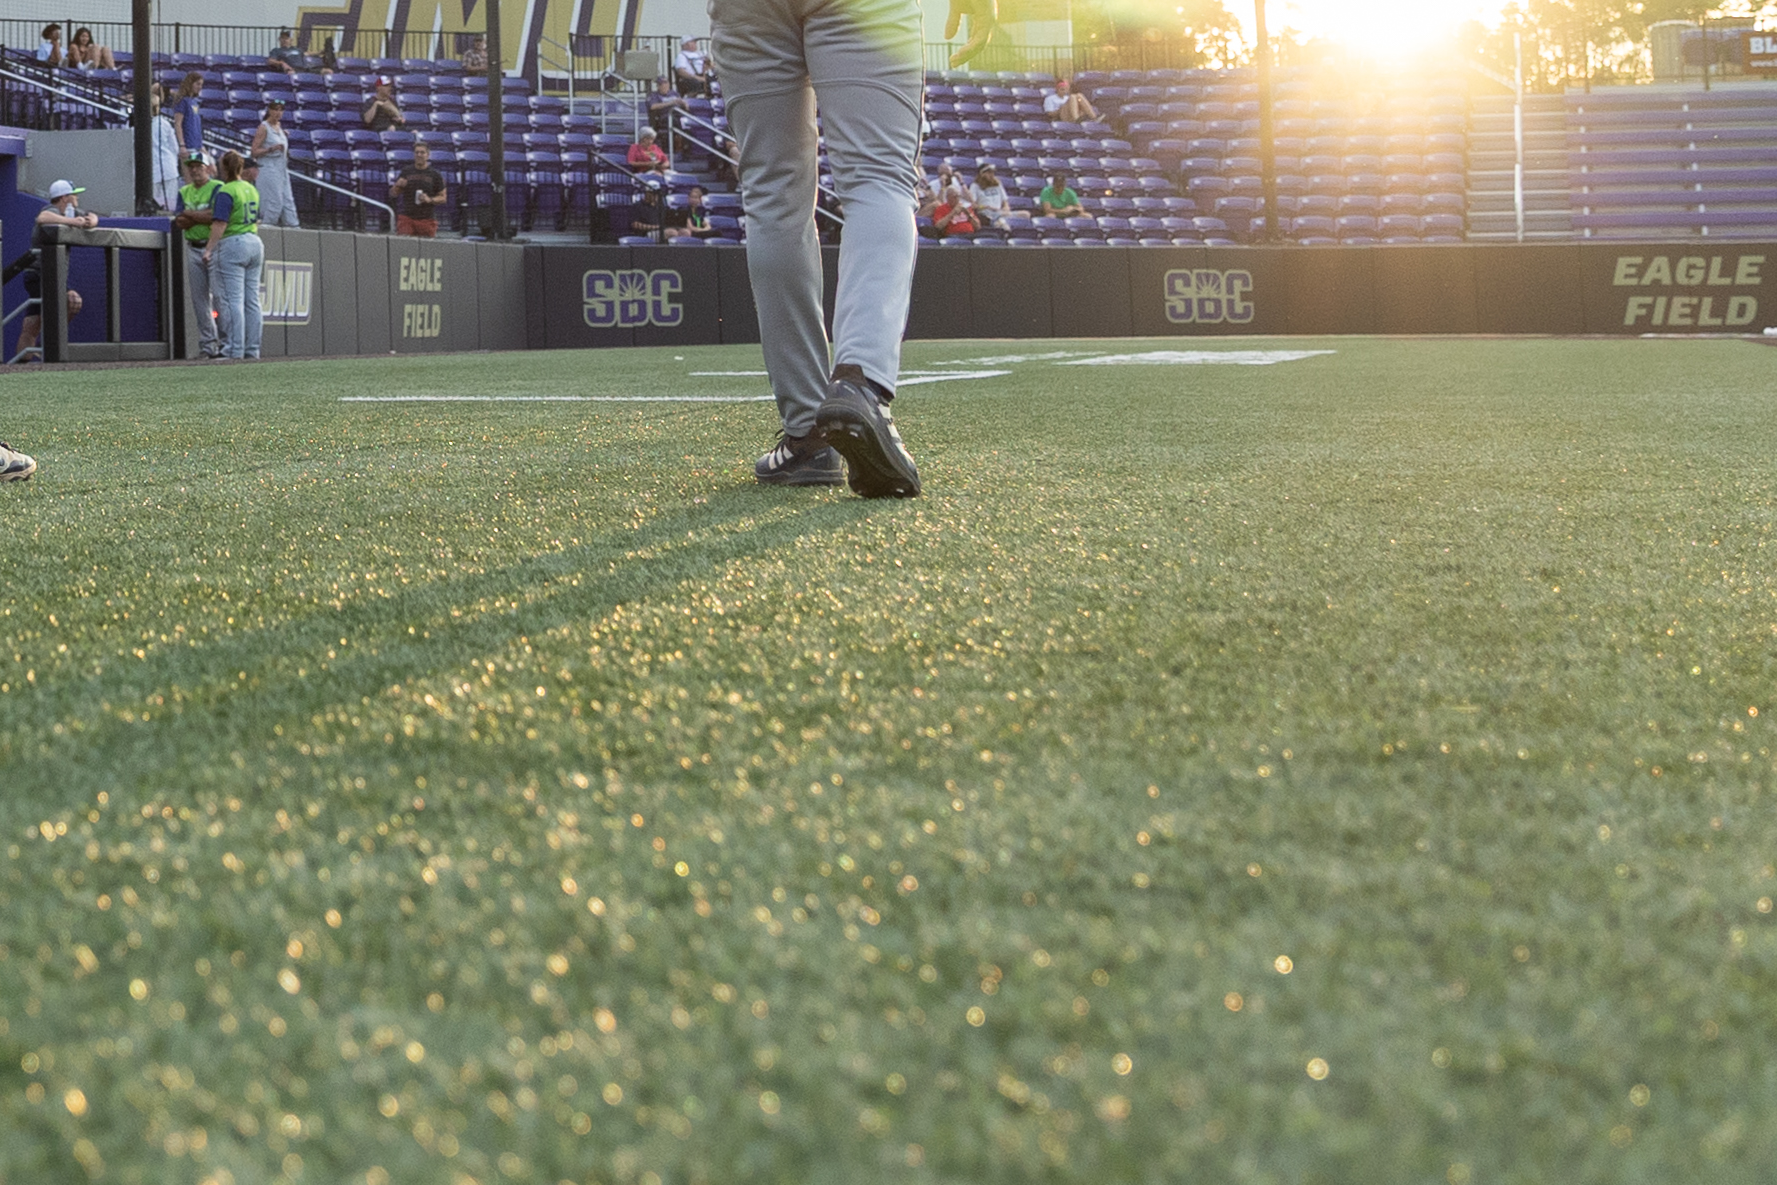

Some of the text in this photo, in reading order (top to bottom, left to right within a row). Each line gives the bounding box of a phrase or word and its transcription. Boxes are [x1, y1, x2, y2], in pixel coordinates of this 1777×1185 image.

[399, 257, 443, 292] EAGLE
[1612, 255, 1766, 286] EAGLE
[259, 259, 314, 326] JMU
[582, 269, 683, 328] SBC
[1164, 269, 1254, 323] SBC
[402, 304, 442, 338] FIELD
[1624, 296, 1759, 326] FIELD
